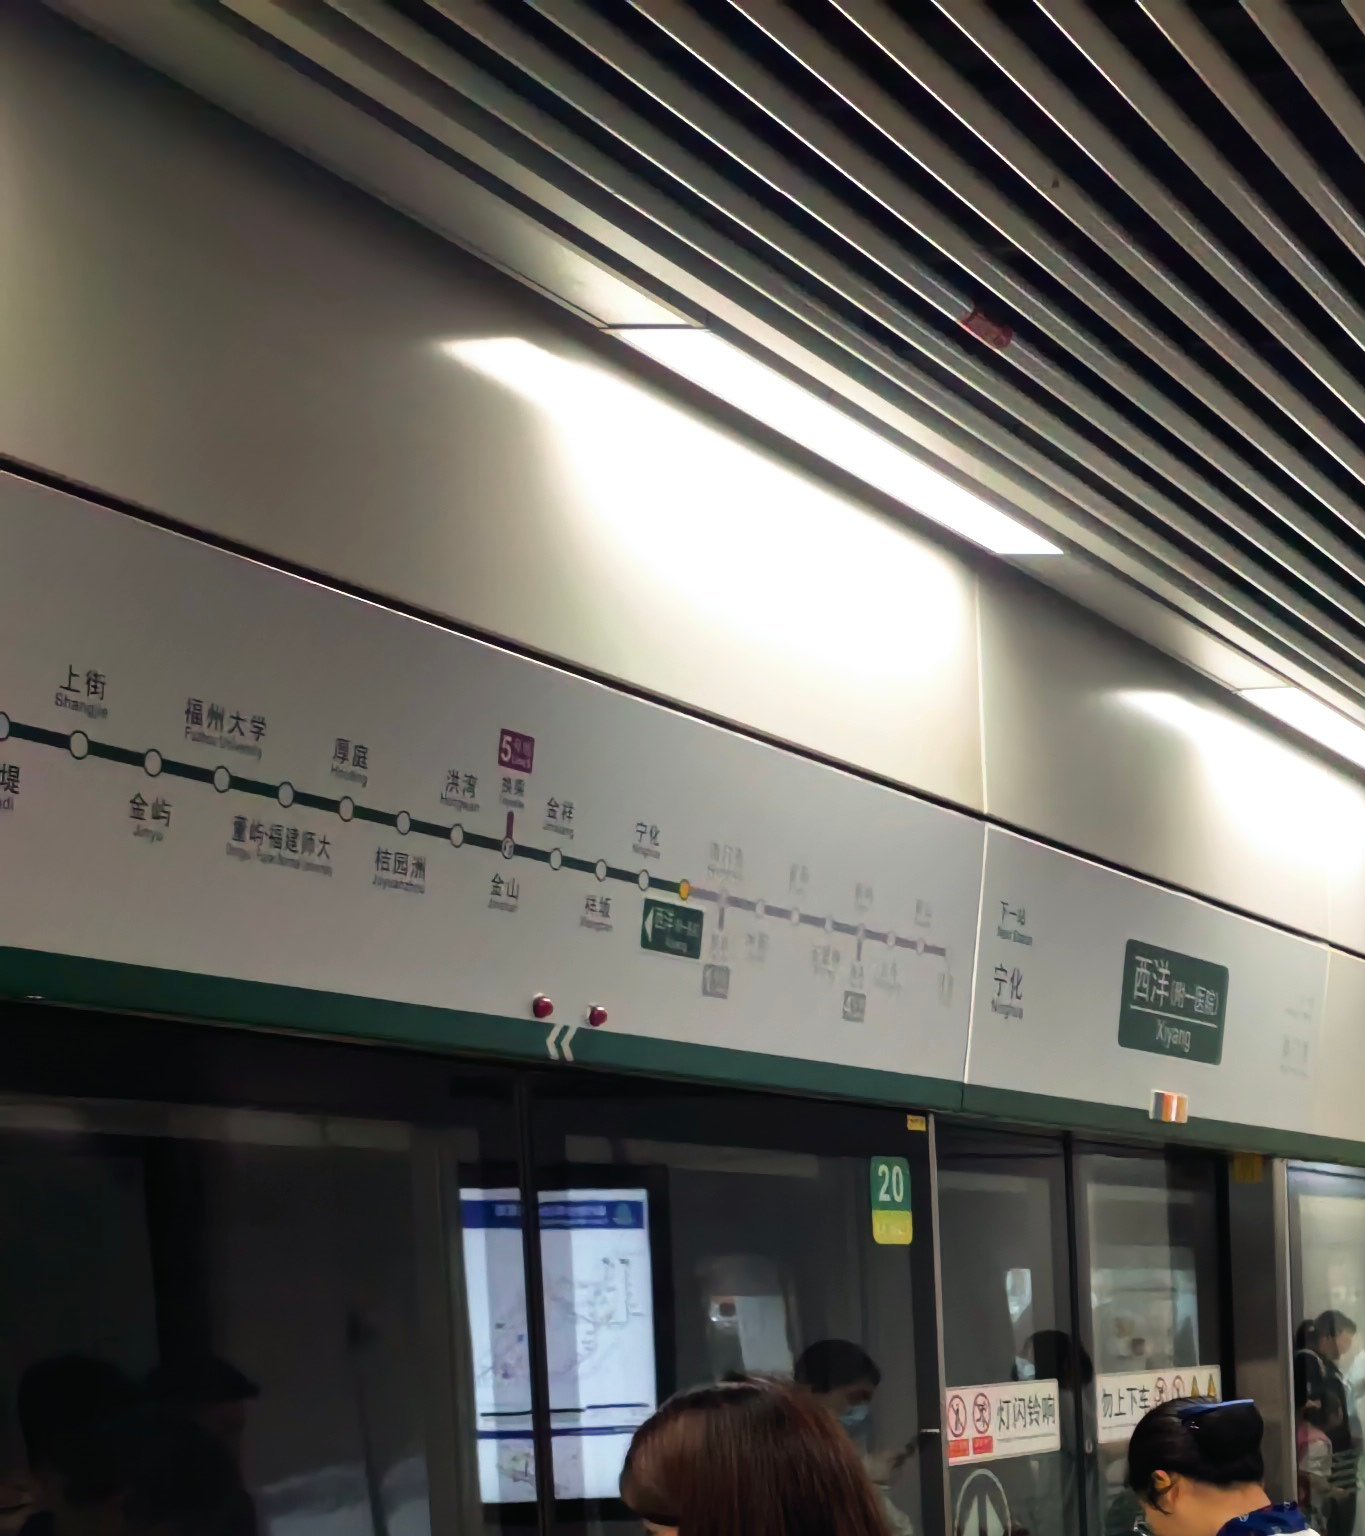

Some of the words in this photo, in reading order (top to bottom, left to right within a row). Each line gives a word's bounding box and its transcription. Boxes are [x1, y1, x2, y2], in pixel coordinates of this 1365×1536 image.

[60, 664, 106, 700] 上街
[185, 698, 267, 741] 福州大学
[333, 738, 368, 769] 厚庭
[130, 792, 172, 827] 金屿
[635, 822, 661, 847] 宁化
[491, 873, 520, 900] 金山
[994, 963, 1023, 1000] 宁化
[1156, 1019, 1191, 1052] Xiyang
[878, 1164, 904, 1202] 20
[997, 1393, 1056, 1432] 灯闪铃响
[1103, 1385, 1150, 1418] 勿上下车
